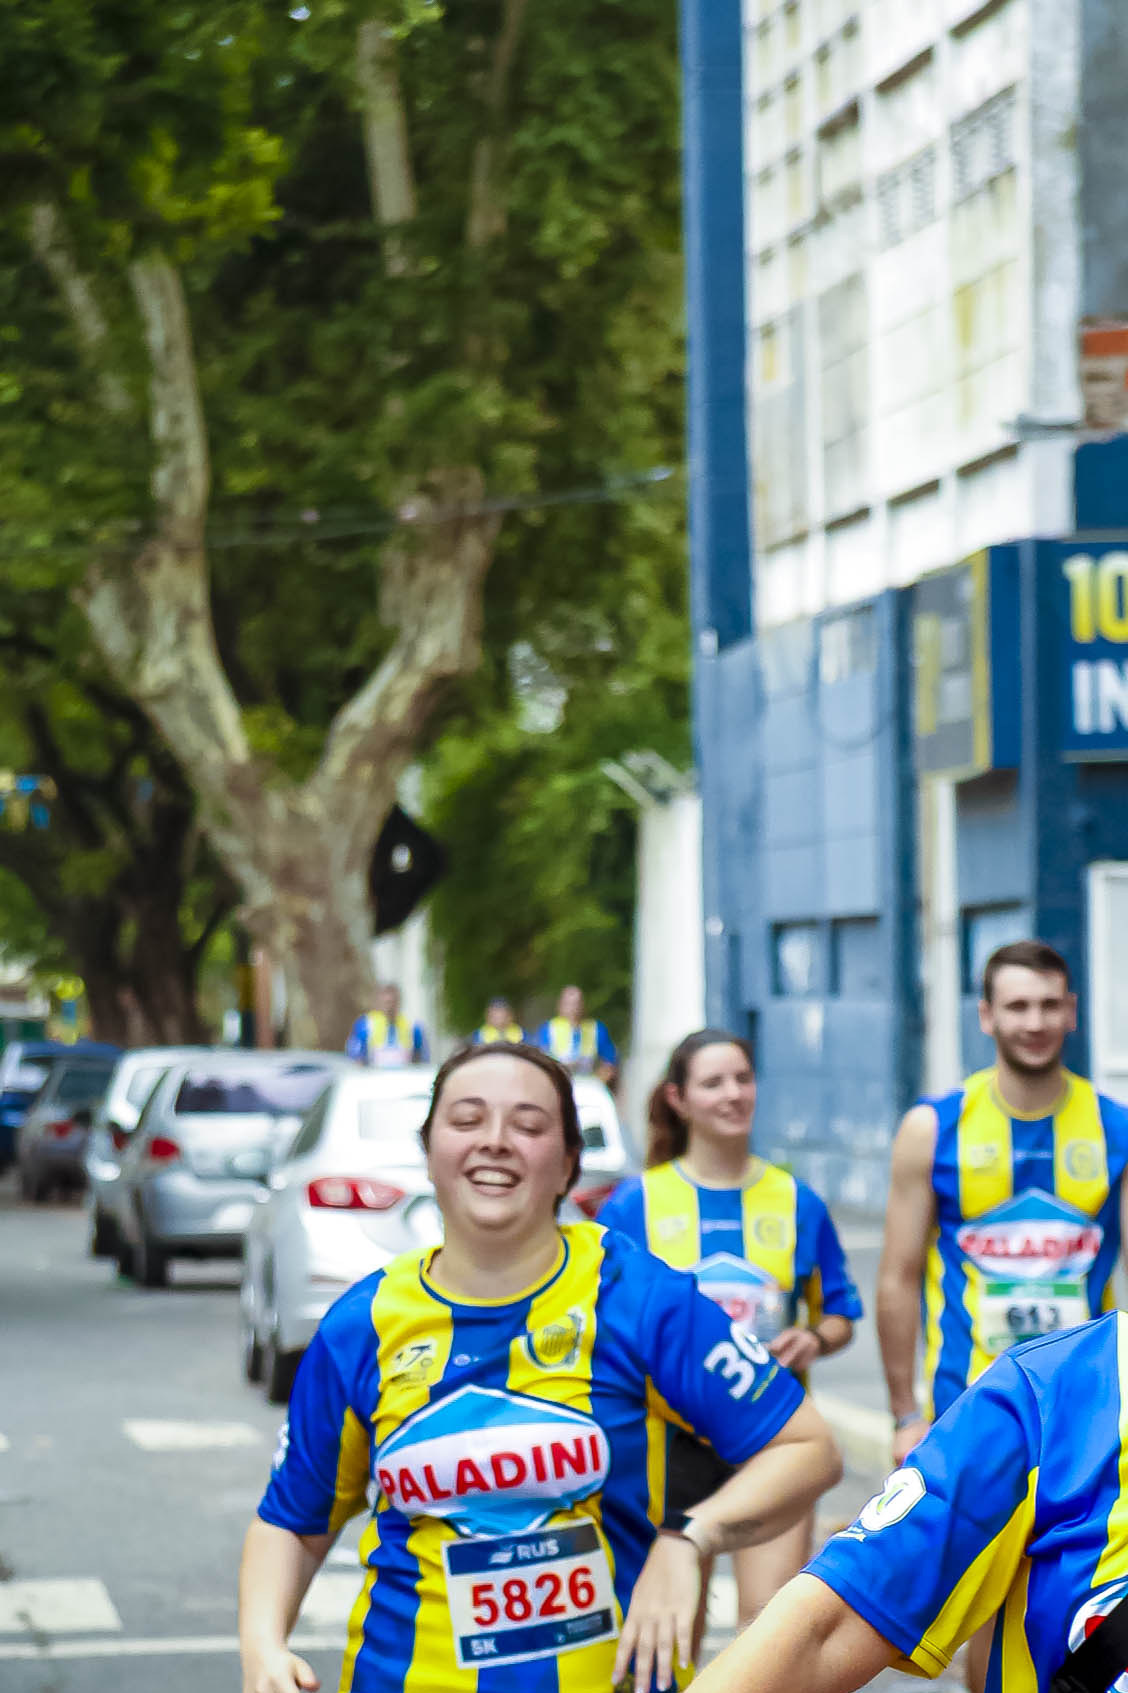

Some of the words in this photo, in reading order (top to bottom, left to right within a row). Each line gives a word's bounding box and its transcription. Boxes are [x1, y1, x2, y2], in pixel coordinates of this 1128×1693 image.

[379, 1434, 601, 1504] PALADINI
[517, 1538, 560, 1560] RUS
[471, 1566, 595, 1627] 5826
[471, 1638, 498, 1656] 5K
